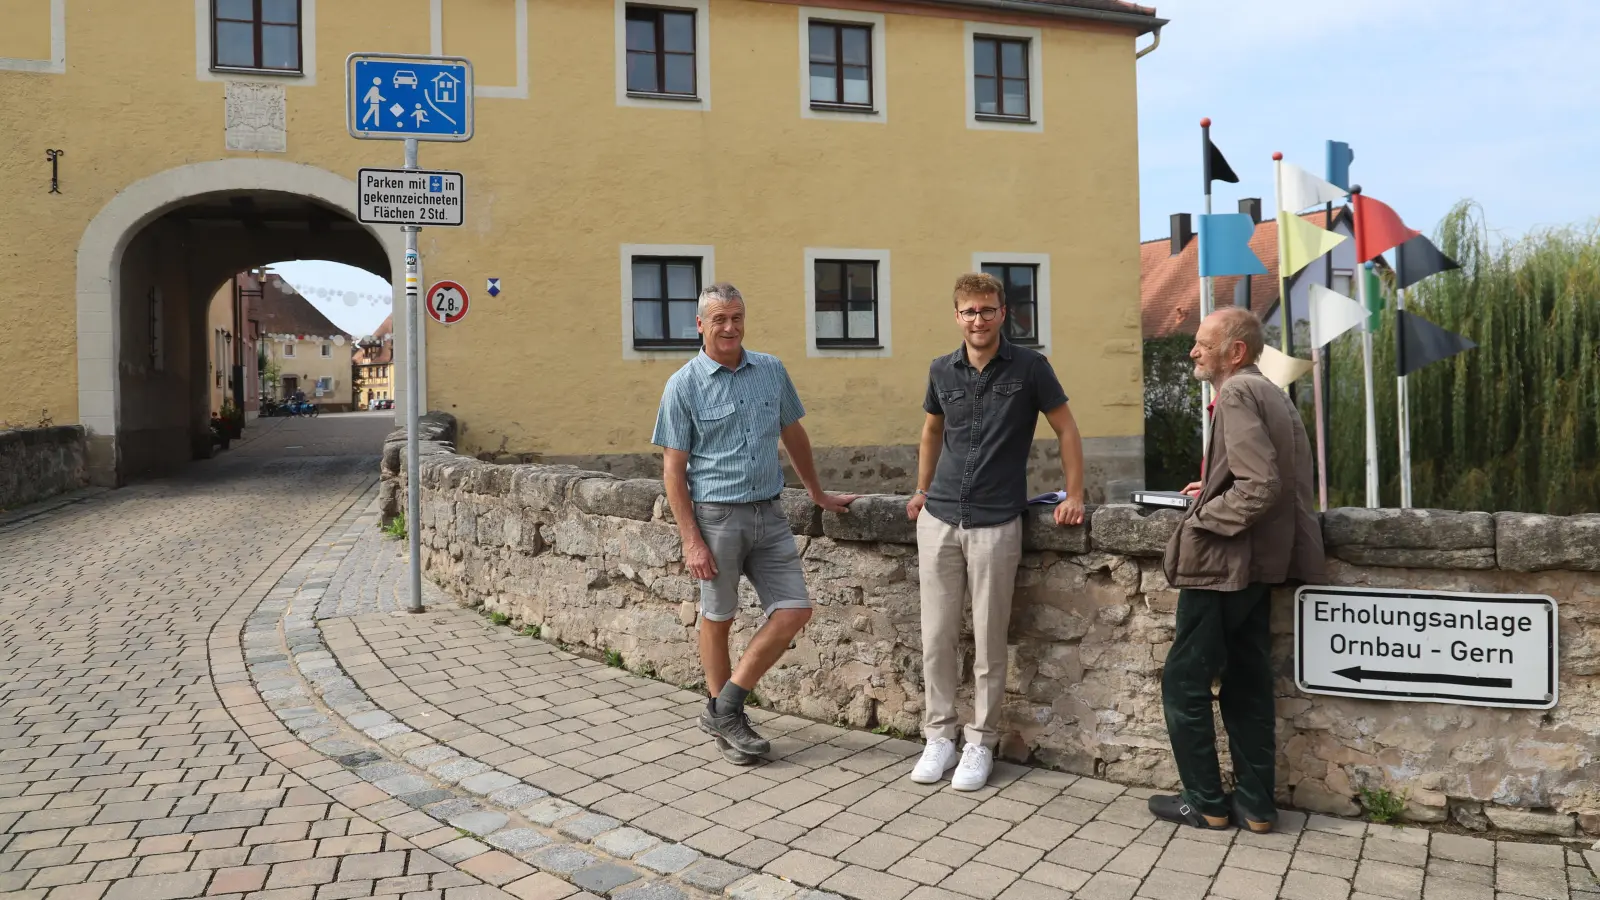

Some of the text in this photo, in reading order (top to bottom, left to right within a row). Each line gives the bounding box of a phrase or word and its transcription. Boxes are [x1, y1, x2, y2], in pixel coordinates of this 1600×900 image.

[367, 176, 455, 191] Parken mit in
[363, 191, 458, 205] gekennzeichneten
[373, 206, 448, 220] Flächen 2 Std.
[1314, 601, 1532, 637] Erholungsanlage
[1330, 633, 1421, 659] Ornbau
[1450, 640, 1514, 664] Gern
